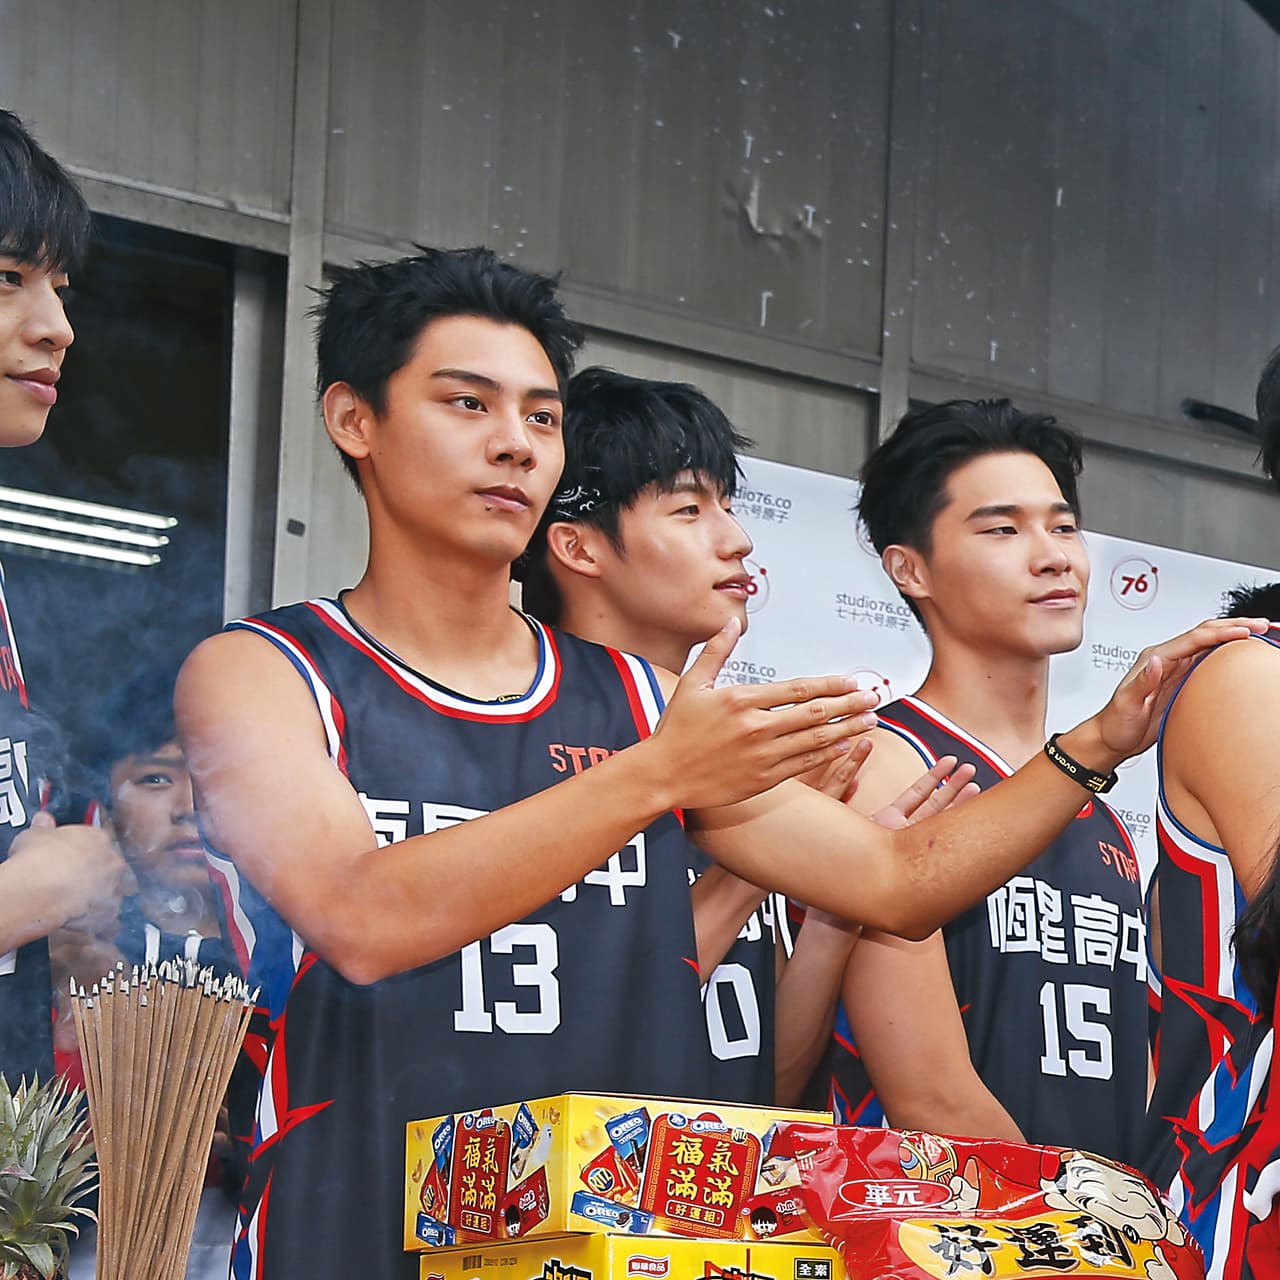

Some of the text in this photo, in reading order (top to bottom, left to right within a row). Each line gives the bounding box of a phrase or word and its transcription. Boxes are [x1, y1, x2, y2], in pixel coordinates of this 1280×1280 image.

[1121, 574, 1148, 595] 76
[836, 592, 912, 617] studio76.co
[453, 923, 561, 1034] 13
[1039, 981, 1114, 1081] 15
[610, 1117, 643, 1138] OREO
[692, 1119, 728, 1131] OREO
[462, 1136, 499, 1173] 福氣
[668, 1134, 739, 1178] 福氣
[460, 1172, 498, 1212] 滿滿
[665, 1167, 736, 1209] 滿滿
[864, 1183, 925, 1206] 華元
[583, 1205, 619, 1220] OREO
[929, 1215, 1136, 1278] 好運到
[799, 1263, 828, 1277] 全素
